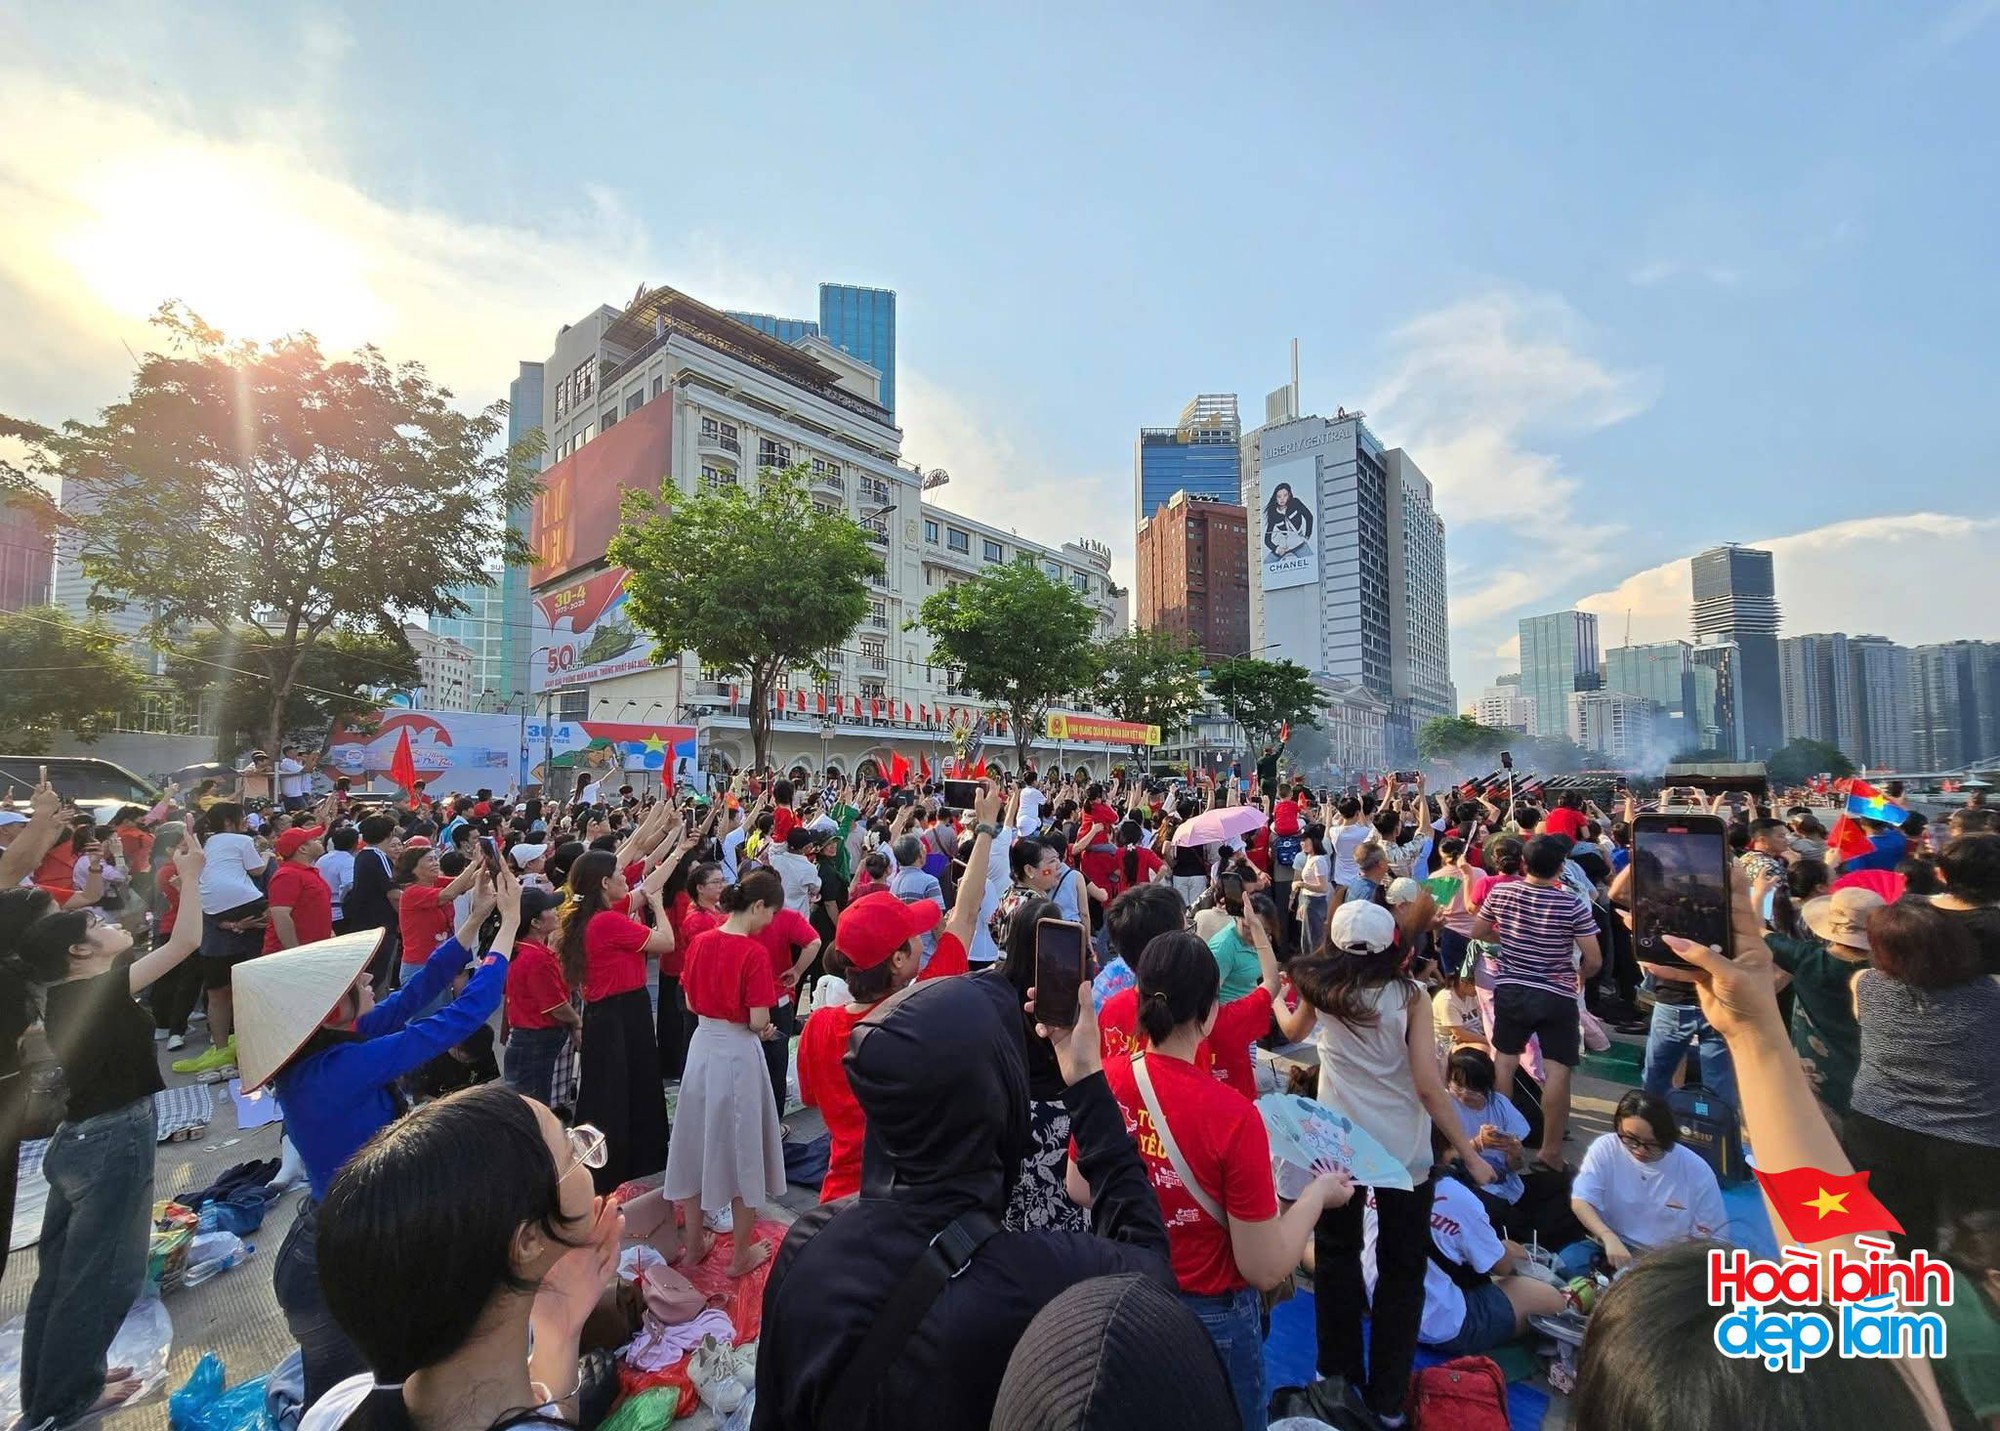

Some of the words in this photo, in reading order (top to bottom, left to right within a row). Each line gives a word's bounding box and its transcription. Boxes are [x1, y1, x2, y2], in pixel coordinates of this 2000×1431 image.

[1264, 440, 1303, 460] LIBERTY
[1303, 428, 1352, 449] CENTRAL
[1270, 559, 1309, 572] CHANEL
[554, 585, 586, 608] 30-4
[547, 644, 575, 673] 50
